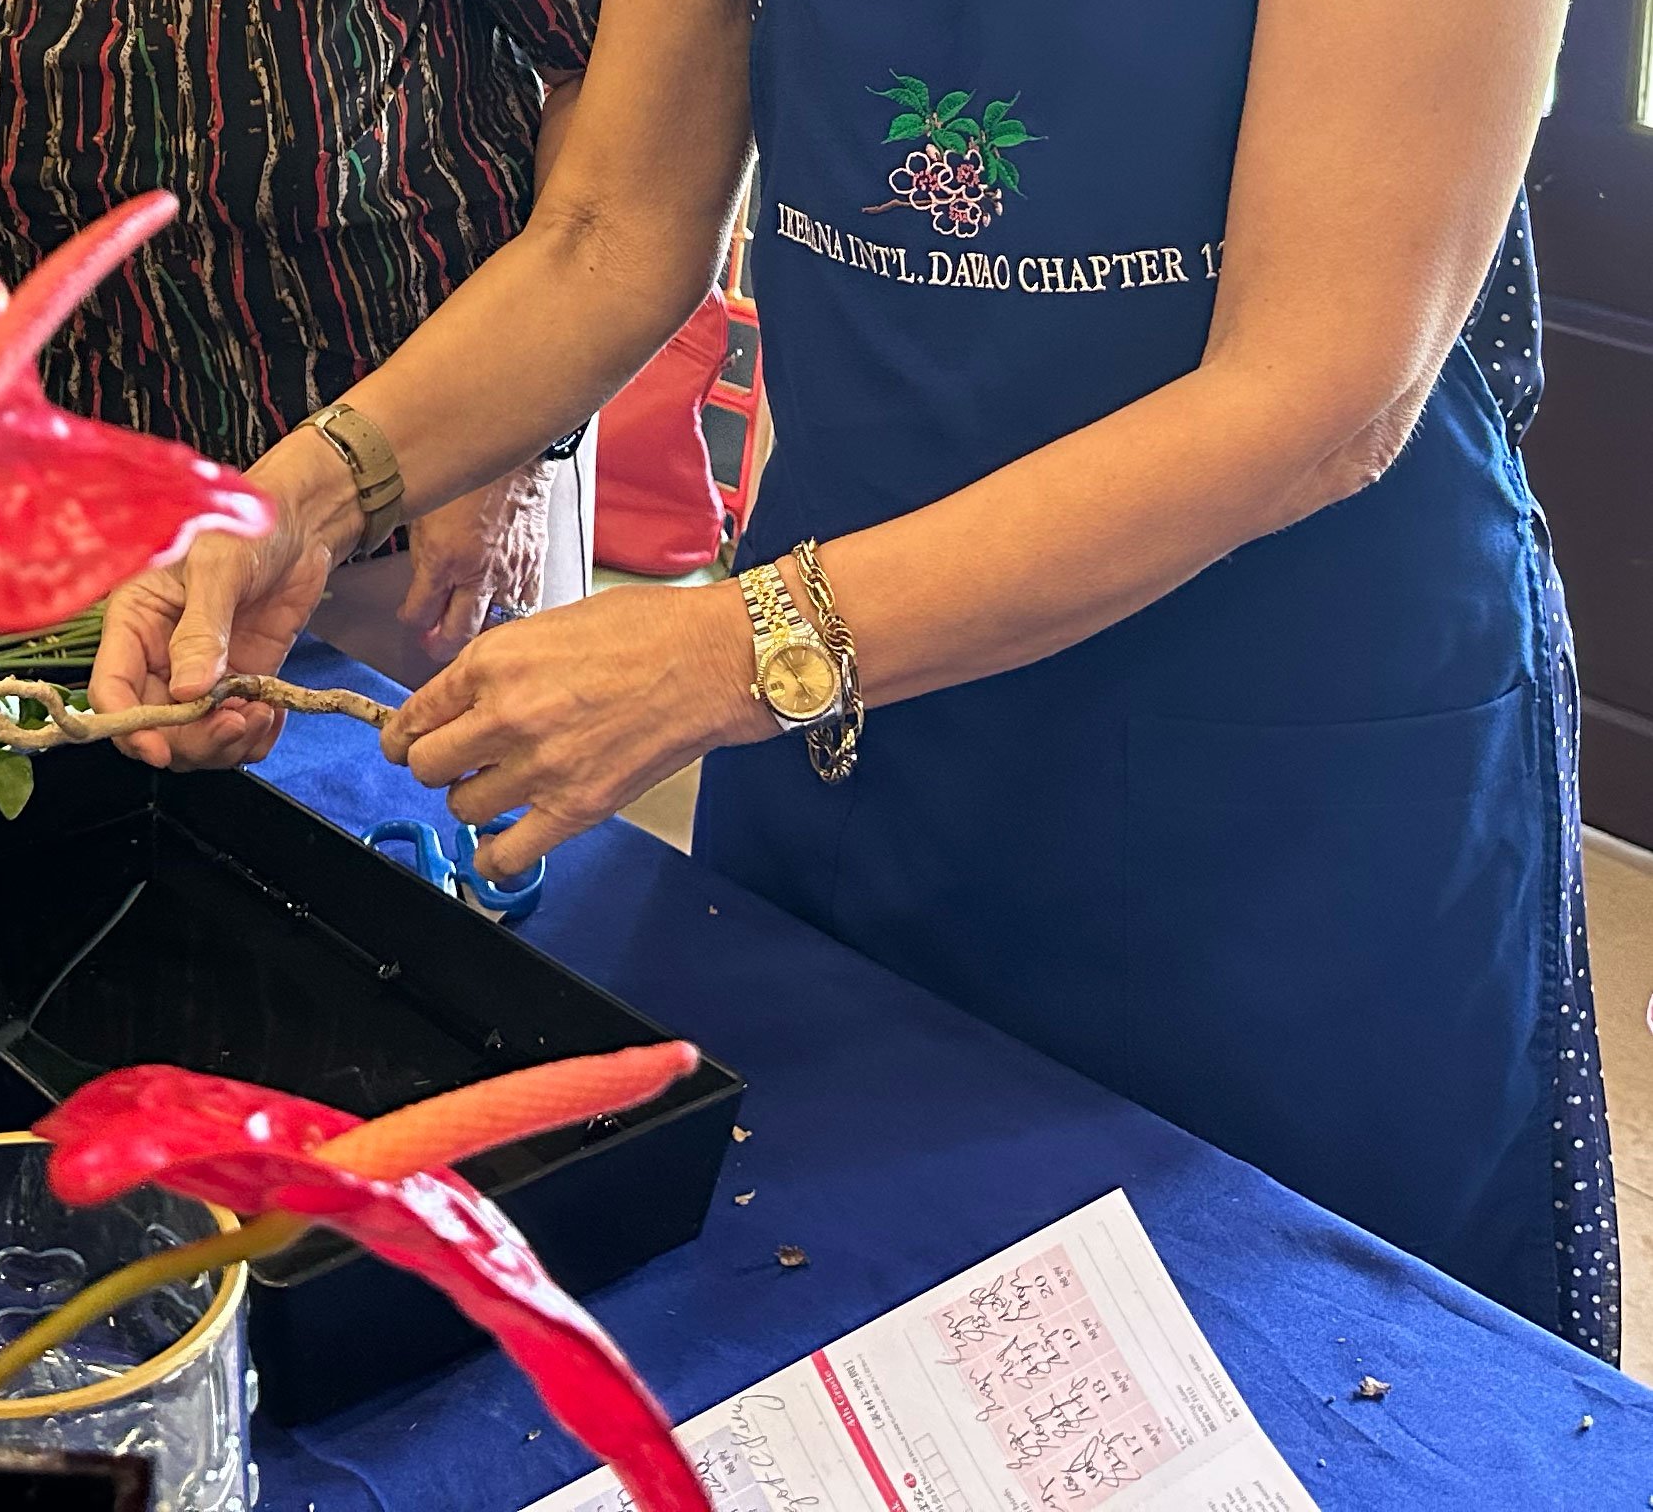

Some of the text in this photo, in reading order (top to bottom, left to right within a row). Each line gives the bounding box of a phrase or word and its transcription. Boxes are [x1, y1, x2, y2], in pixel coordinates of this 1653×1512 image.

[928, 251, 1011, 290] DAVAO
[1017, 247, 1189, 293] CHAPTER
[1201, 241, 1225, 279] 1
[1034, 1274, 1055, 1299] 20
[1062, 1328, 1082, 1351] 19
[1092, 1379, 1112, 1404] 18
[1122, 1435, 1145, 1457] 17
